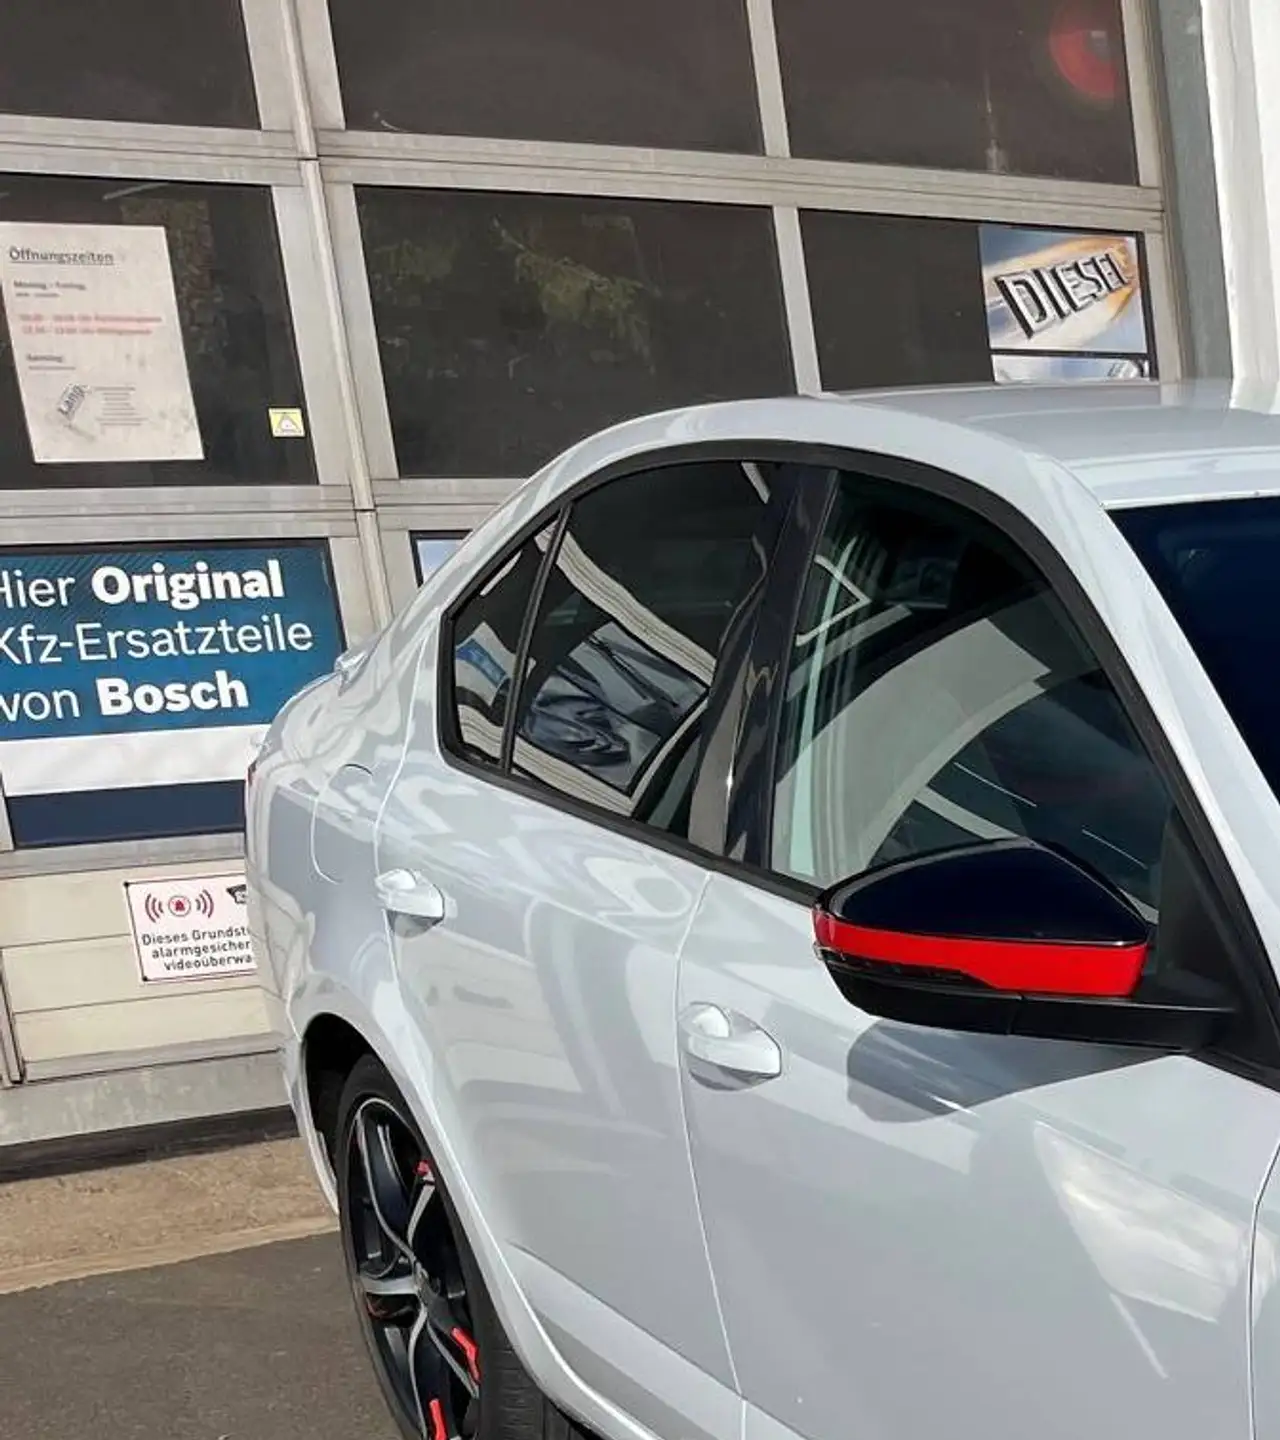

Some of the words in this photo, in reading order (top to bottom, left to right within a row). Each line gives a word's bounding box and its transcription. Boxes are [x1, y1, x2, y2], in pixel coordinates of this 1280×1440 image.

[994, 252, 1132, 340] DIESEL
[0, 568, 76, 609] Hier
[91, 559, 286, 611] Original
[0, 613, 313, 666] Kfz-Ersatzteile
[0, 688, 80, 723] von
[95, 670, 250, 716] Bosch
[141, 932, 189, 946] Dieses
[192, 926, 248, 942] Grundst
[152, 939, 251, 959] alarmgesicher
